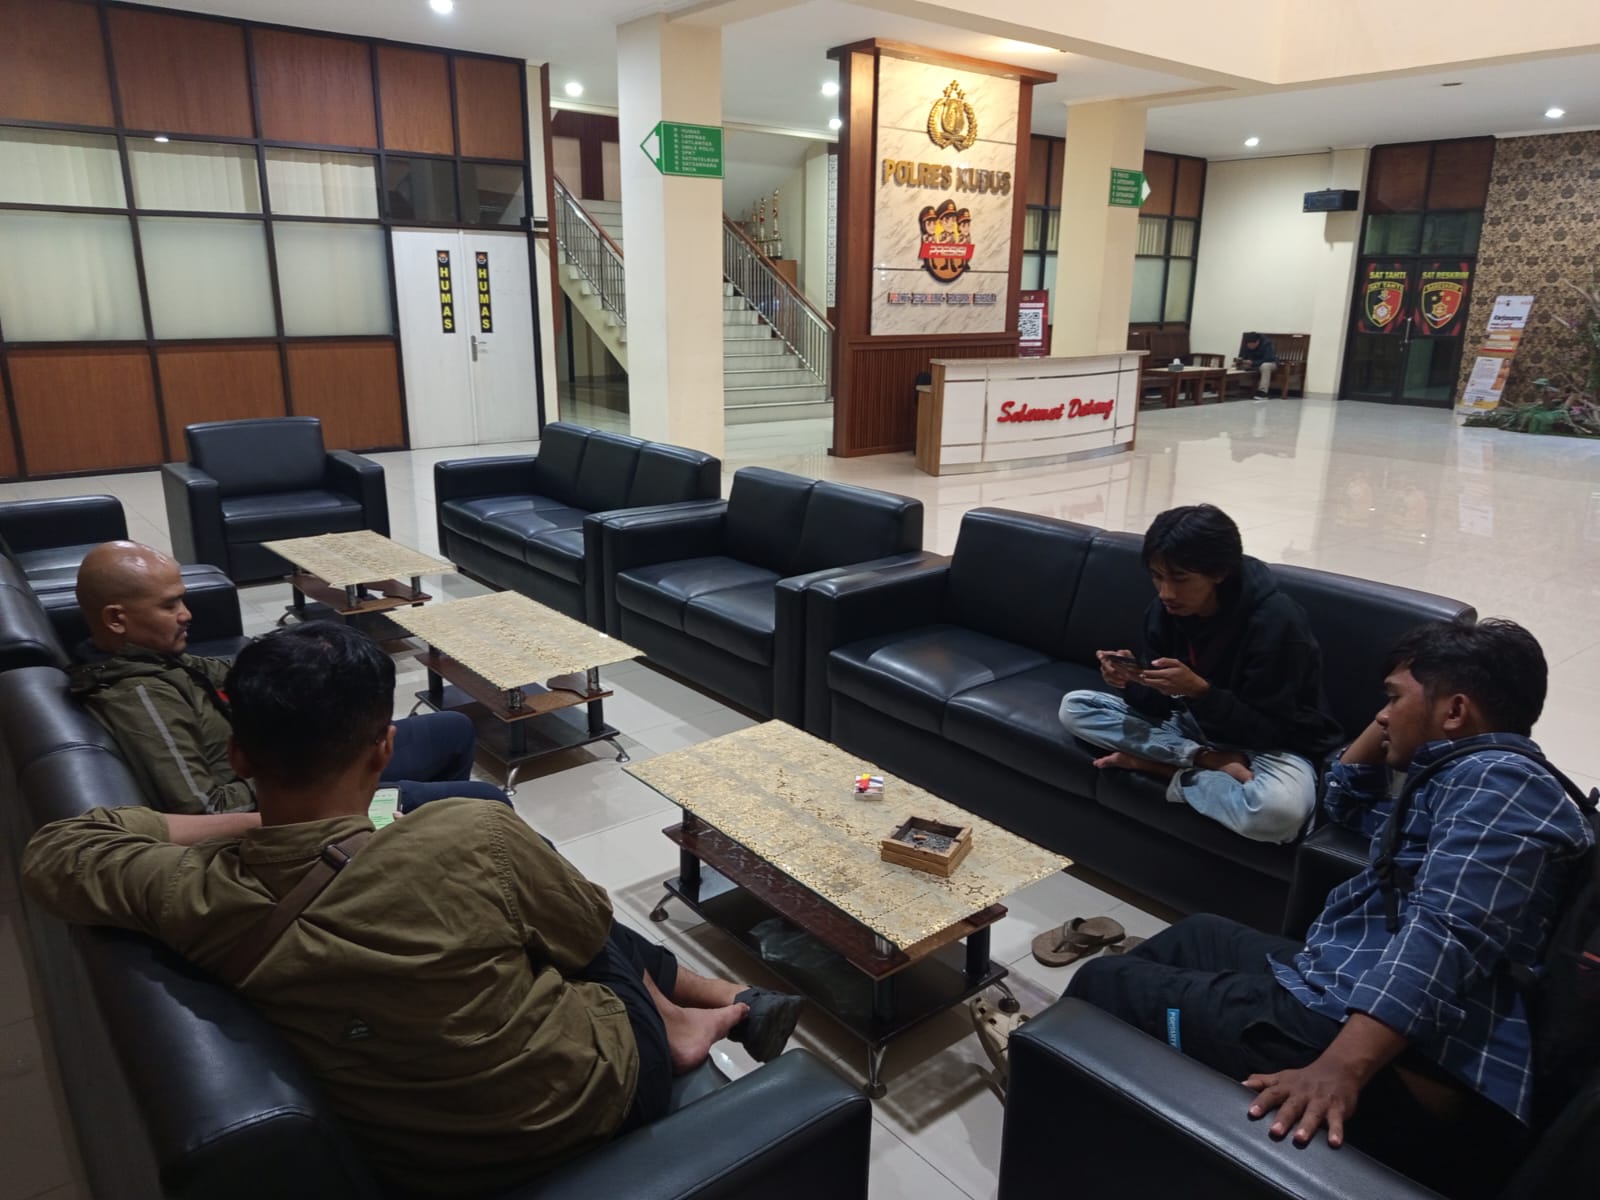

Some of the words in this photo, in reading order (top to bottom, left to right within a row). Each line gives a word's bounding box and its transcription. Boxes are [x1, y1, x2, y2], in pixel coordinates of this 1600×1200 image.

[882, 159, 952, 190] POLRES
[956, 167, 1011, 196] KUDUS
[440, 266, 453, 329] HUMAS
[478, 268, 491, 329] HUMAS
[997, 401, 1065, 423] Selamat
[1067, 398, 1114, 420] Datang
